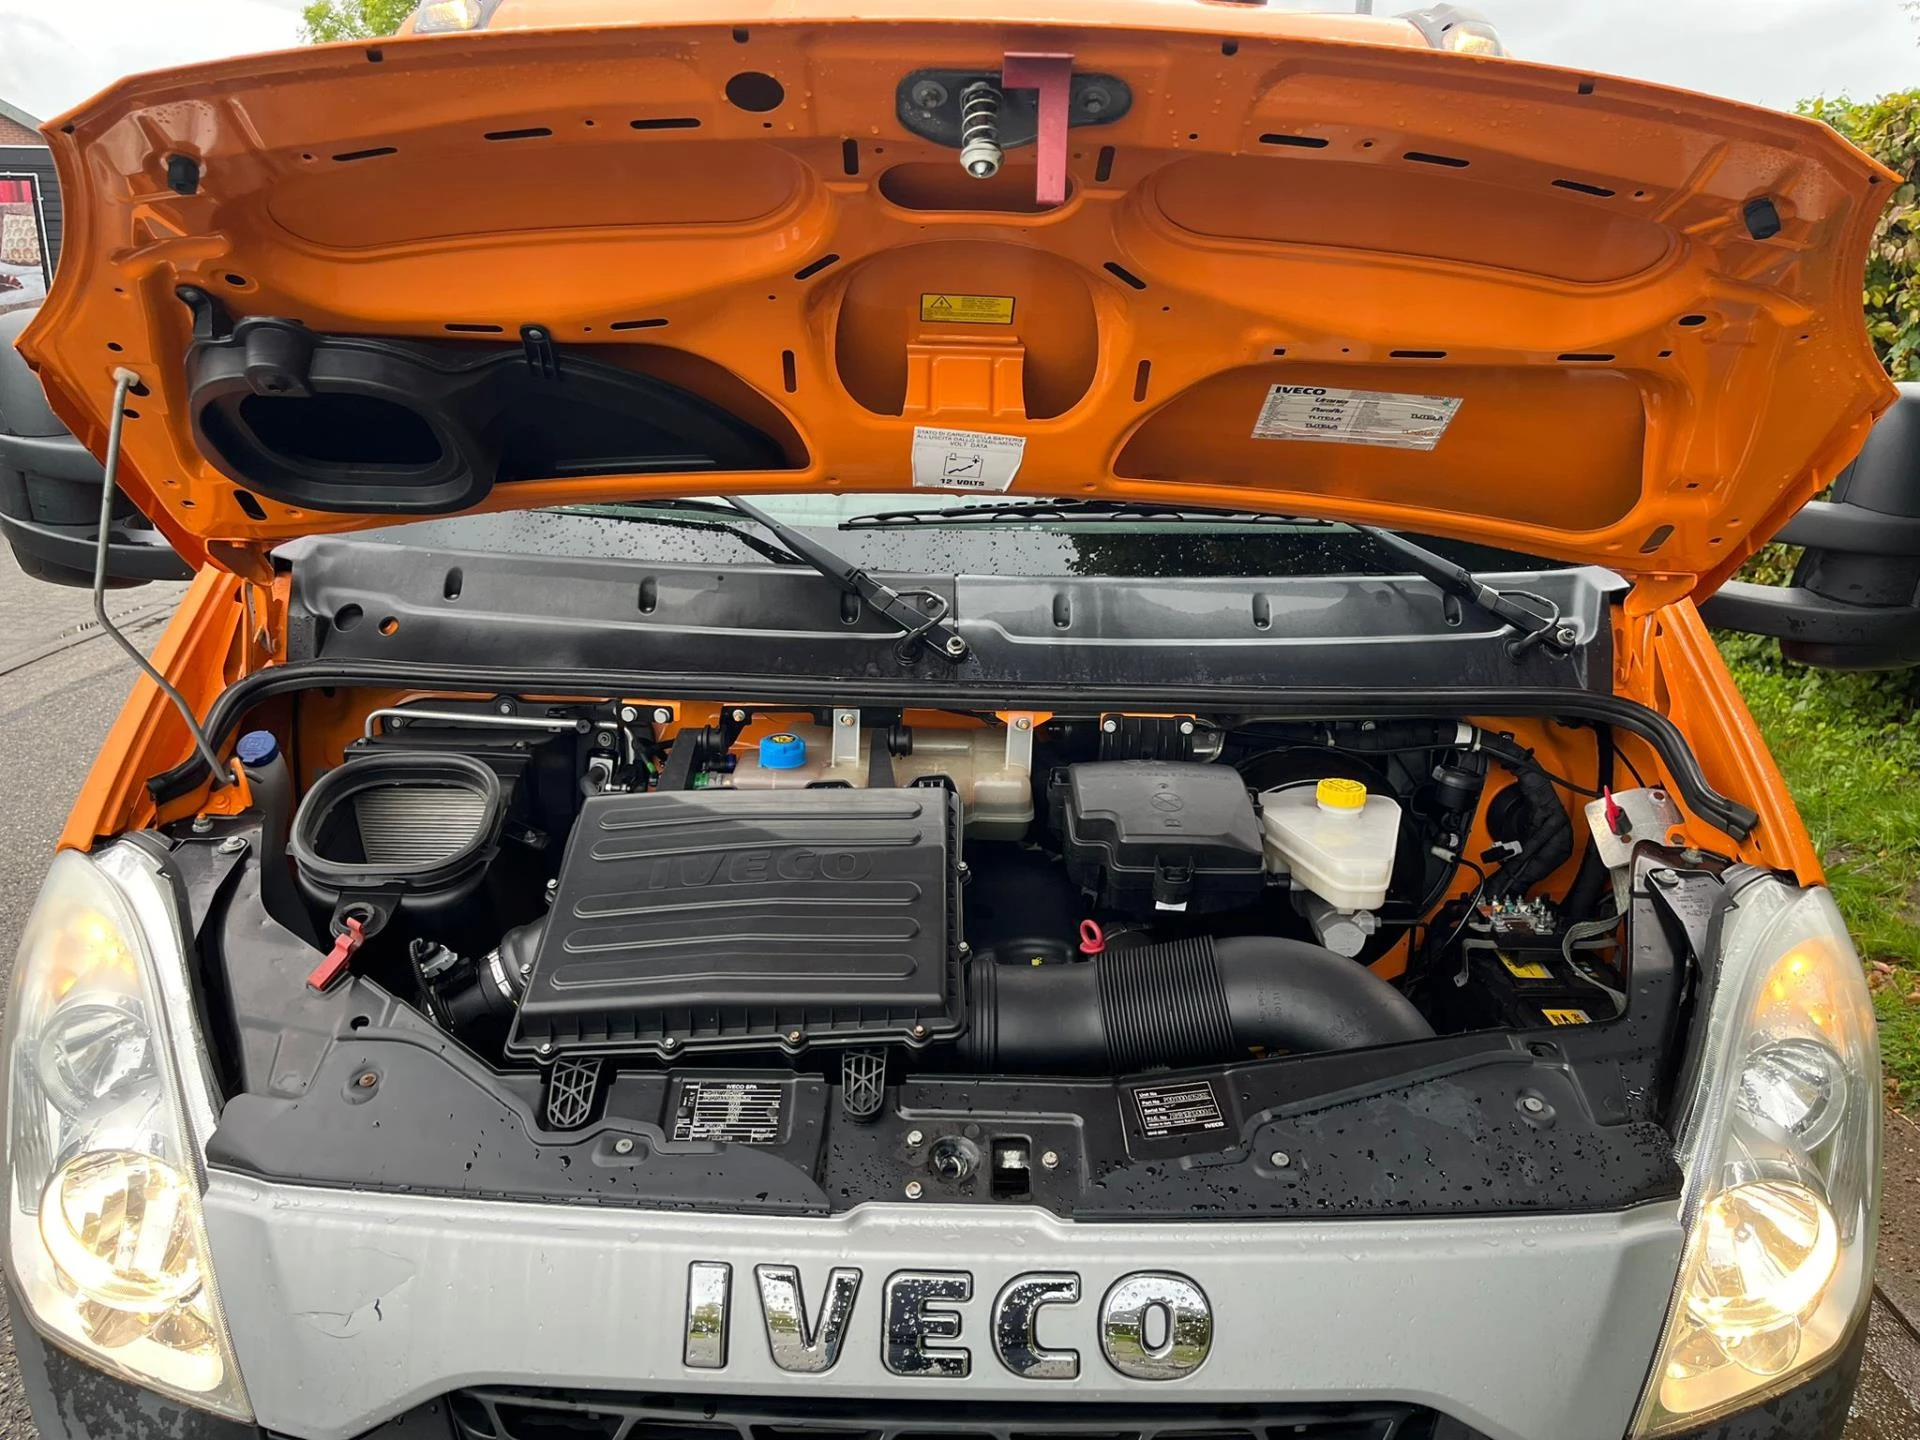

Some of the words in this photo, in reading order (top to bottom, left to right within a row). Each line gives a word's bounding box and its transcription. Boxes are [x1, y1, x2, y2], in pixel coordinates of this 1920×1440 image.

[1275, 386, 1326, 395] IVECO
[649, 849, 874, 890] IVECO
[1204, 1121, 1225, 1129] IVECO
[682, 1260, 1214, 1380] IVECO
